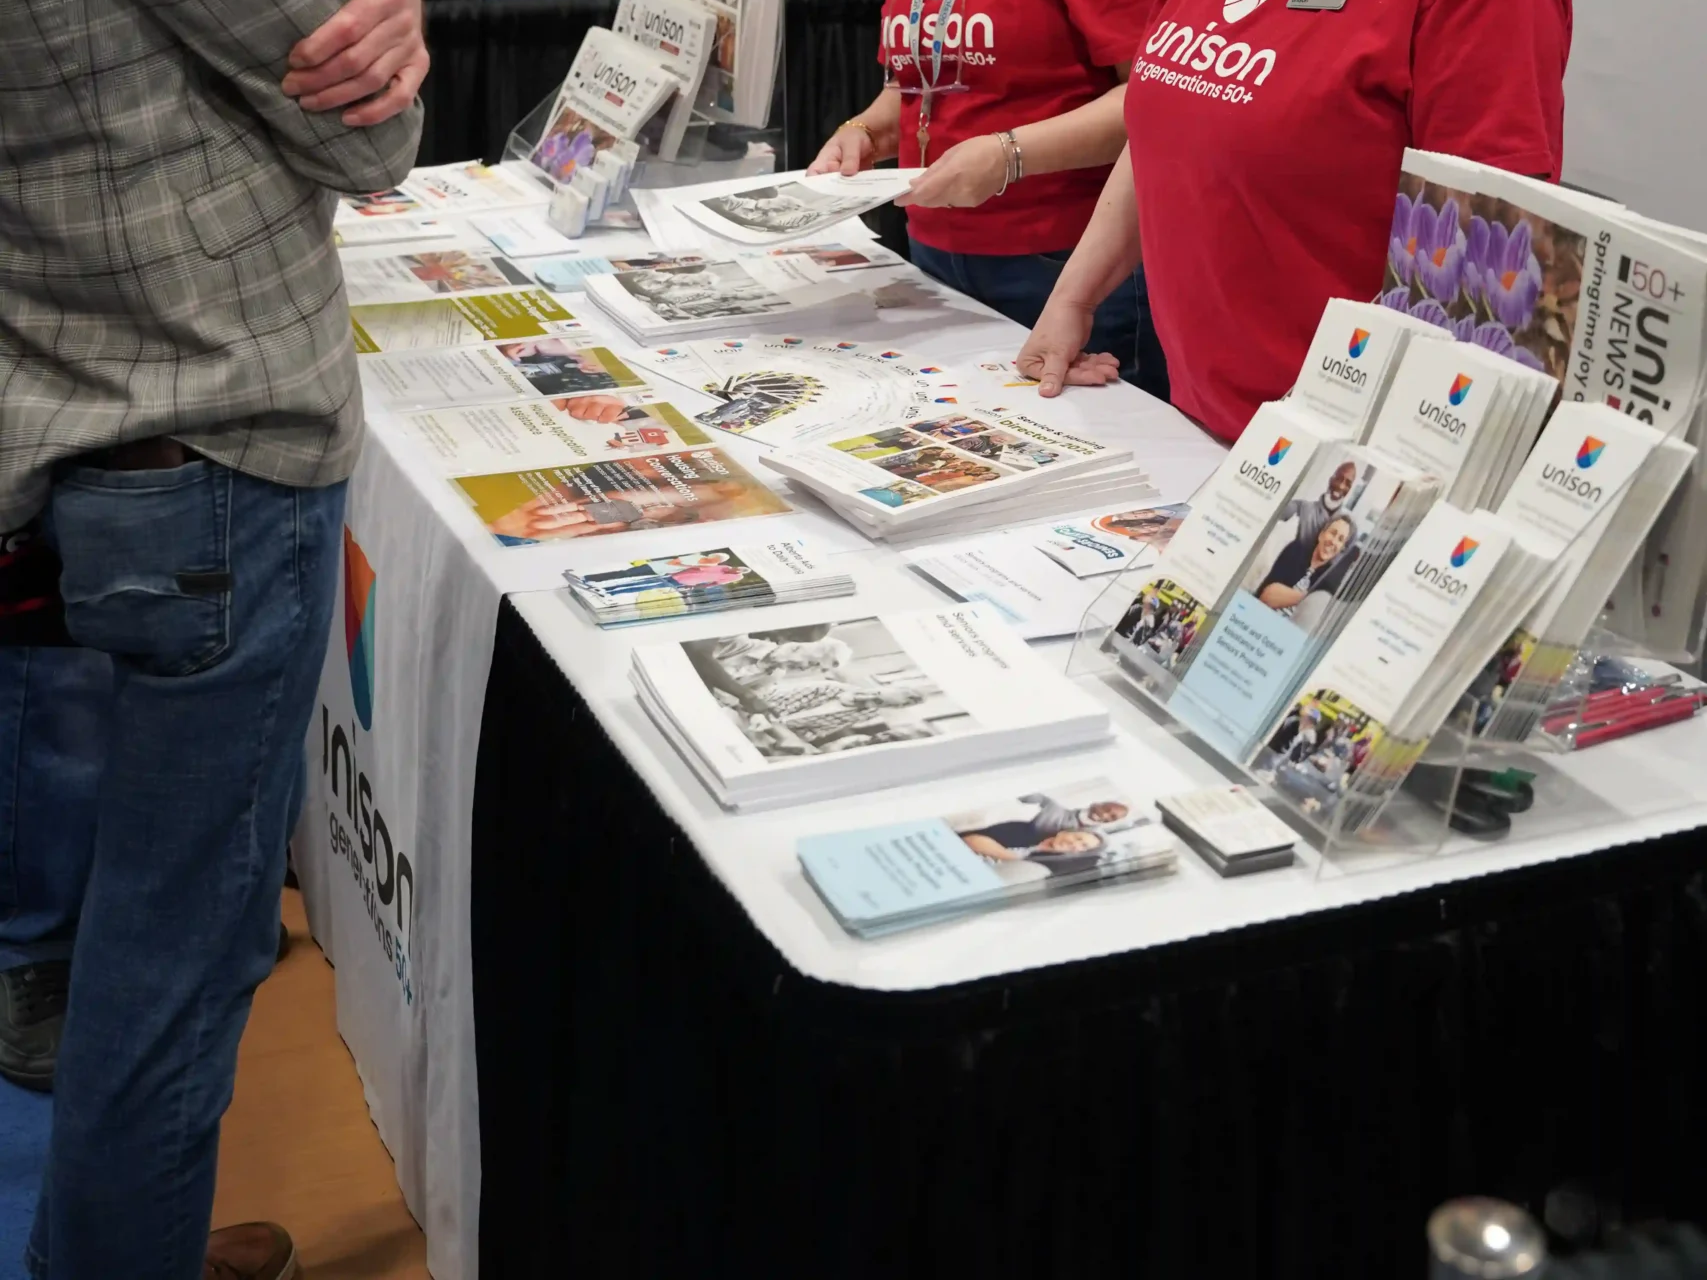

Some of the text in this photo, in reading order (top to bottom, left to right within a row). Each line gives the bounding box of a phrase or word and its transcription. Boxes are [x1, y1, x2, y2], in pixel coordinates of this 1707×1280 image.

[645, 9, 684, 44] unison
[964, 52, 996, 65] 50+
[1146, 21, 1276, 87] unison
[594, 62, 637, 97] unison
[1140, 63, 1223, 98] generations
[1222, 83, 1253, 104] 50+
[1631, 260, 1685, 302] 50+
[1603, 292, 1634, 391] NEWS
[1322, 355, 1367, 387] unison
[1574, 350, 1595, 389] joy
[1017, 415, 1055, 433] Service
[1063, 433, 1106, 450] Housing
[1418, 399, 1467, 437] unison
[550, 425, 588, 457] Application
[999, 419, 1097, 456] Directory 2025
[645, 457, 699, 502] Conversations
[666, 454, 701, 480] Housing
[1239, 460, 1281, 494] unison
[1542, 463, 1602, 503] unison
[1414, 559, 1468, 597] unison
[948, 629, 977, 658] services
[952, 612, 980, 639] Seniors
